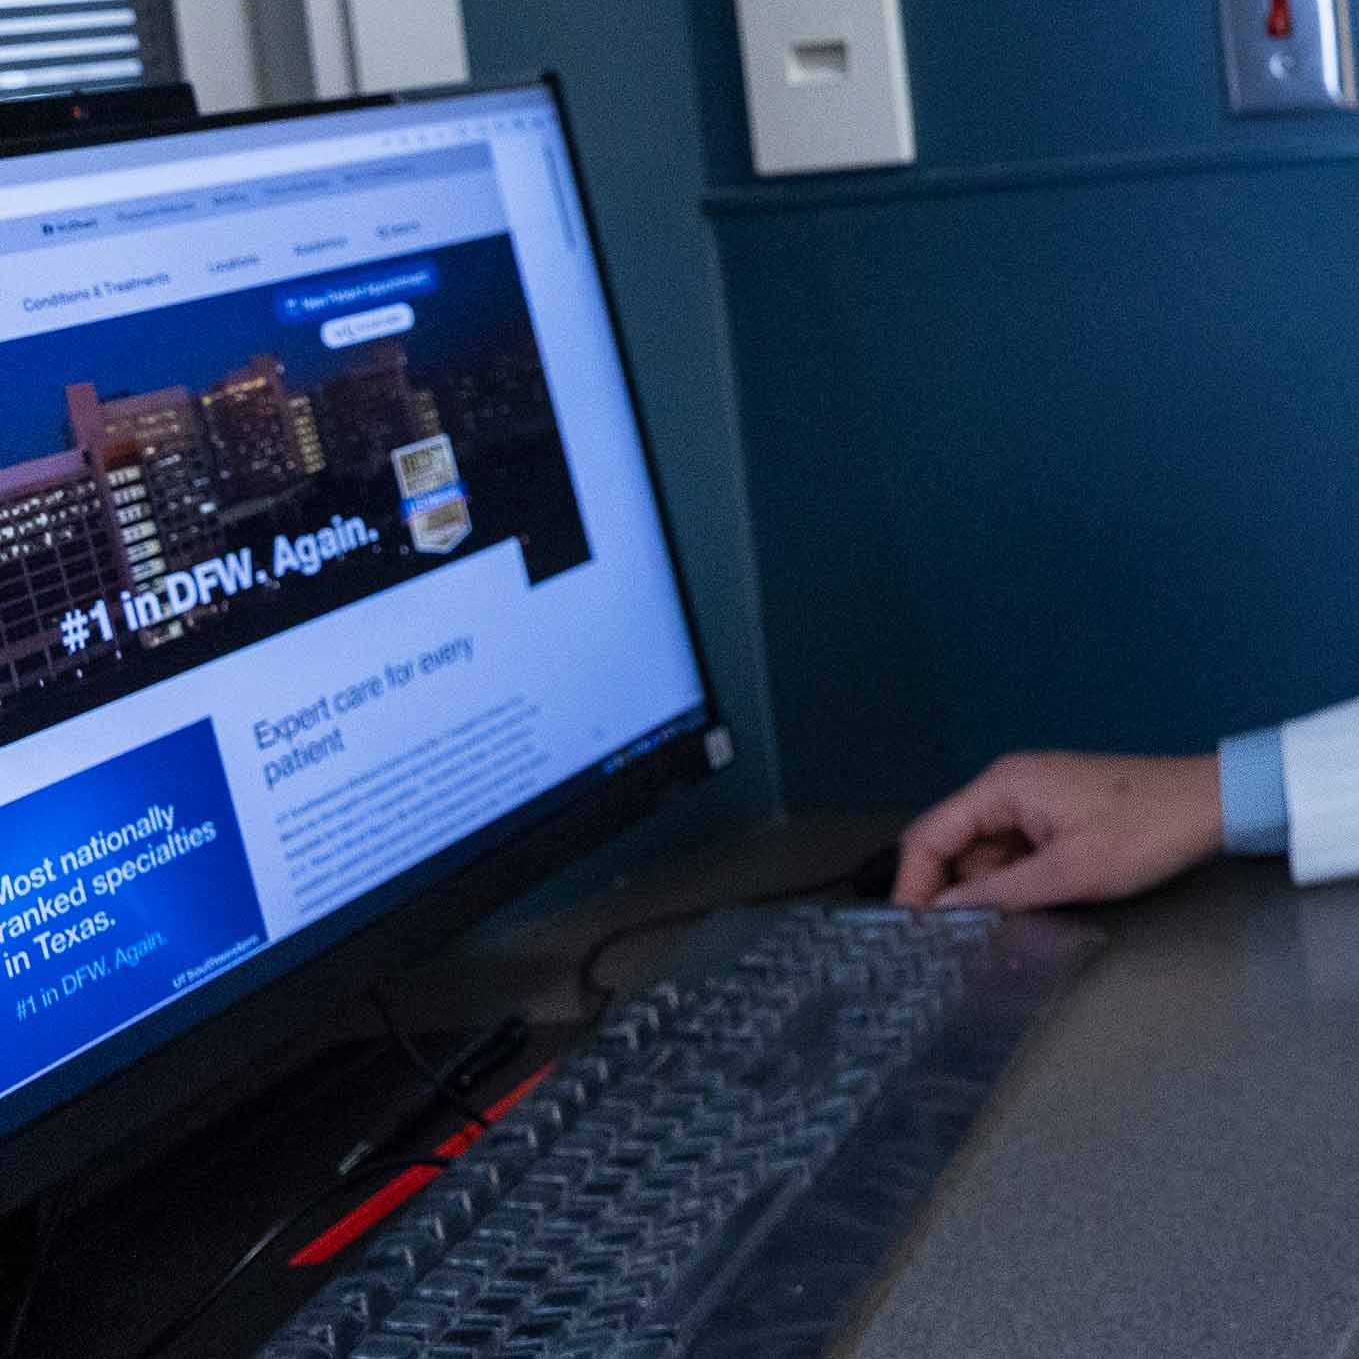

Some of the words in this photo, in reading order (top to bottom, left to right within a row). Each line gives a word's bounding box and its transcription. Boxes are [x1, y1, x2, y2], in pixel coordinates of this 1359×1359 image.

[60, 598, 113, 655] #1
[120, 590, 162, 631] in
[163, 547, 268, 612] DFW.
[273, 514, 380, 577] Again.
[254, 696, 331, 750] Expert
[333, 675, 384, 715] care
[385, 660, 414, 689] for
[419, 637, 475, 675] every
[263, 727, 345, 790] patient
[0, 878, 87, 942] ranked
[91, 820, 217, 896] specialties
[59, 804, 175, 875] nationally
[3, 950, 31, 979] in
[33, 910, 116, 961] Texas.
[16, 996, 37, 1023] #1
[41, 986, 60, 1009] in
[61, 955, 112, 997] DFW.
[115, 930, 169, 970] Again.
